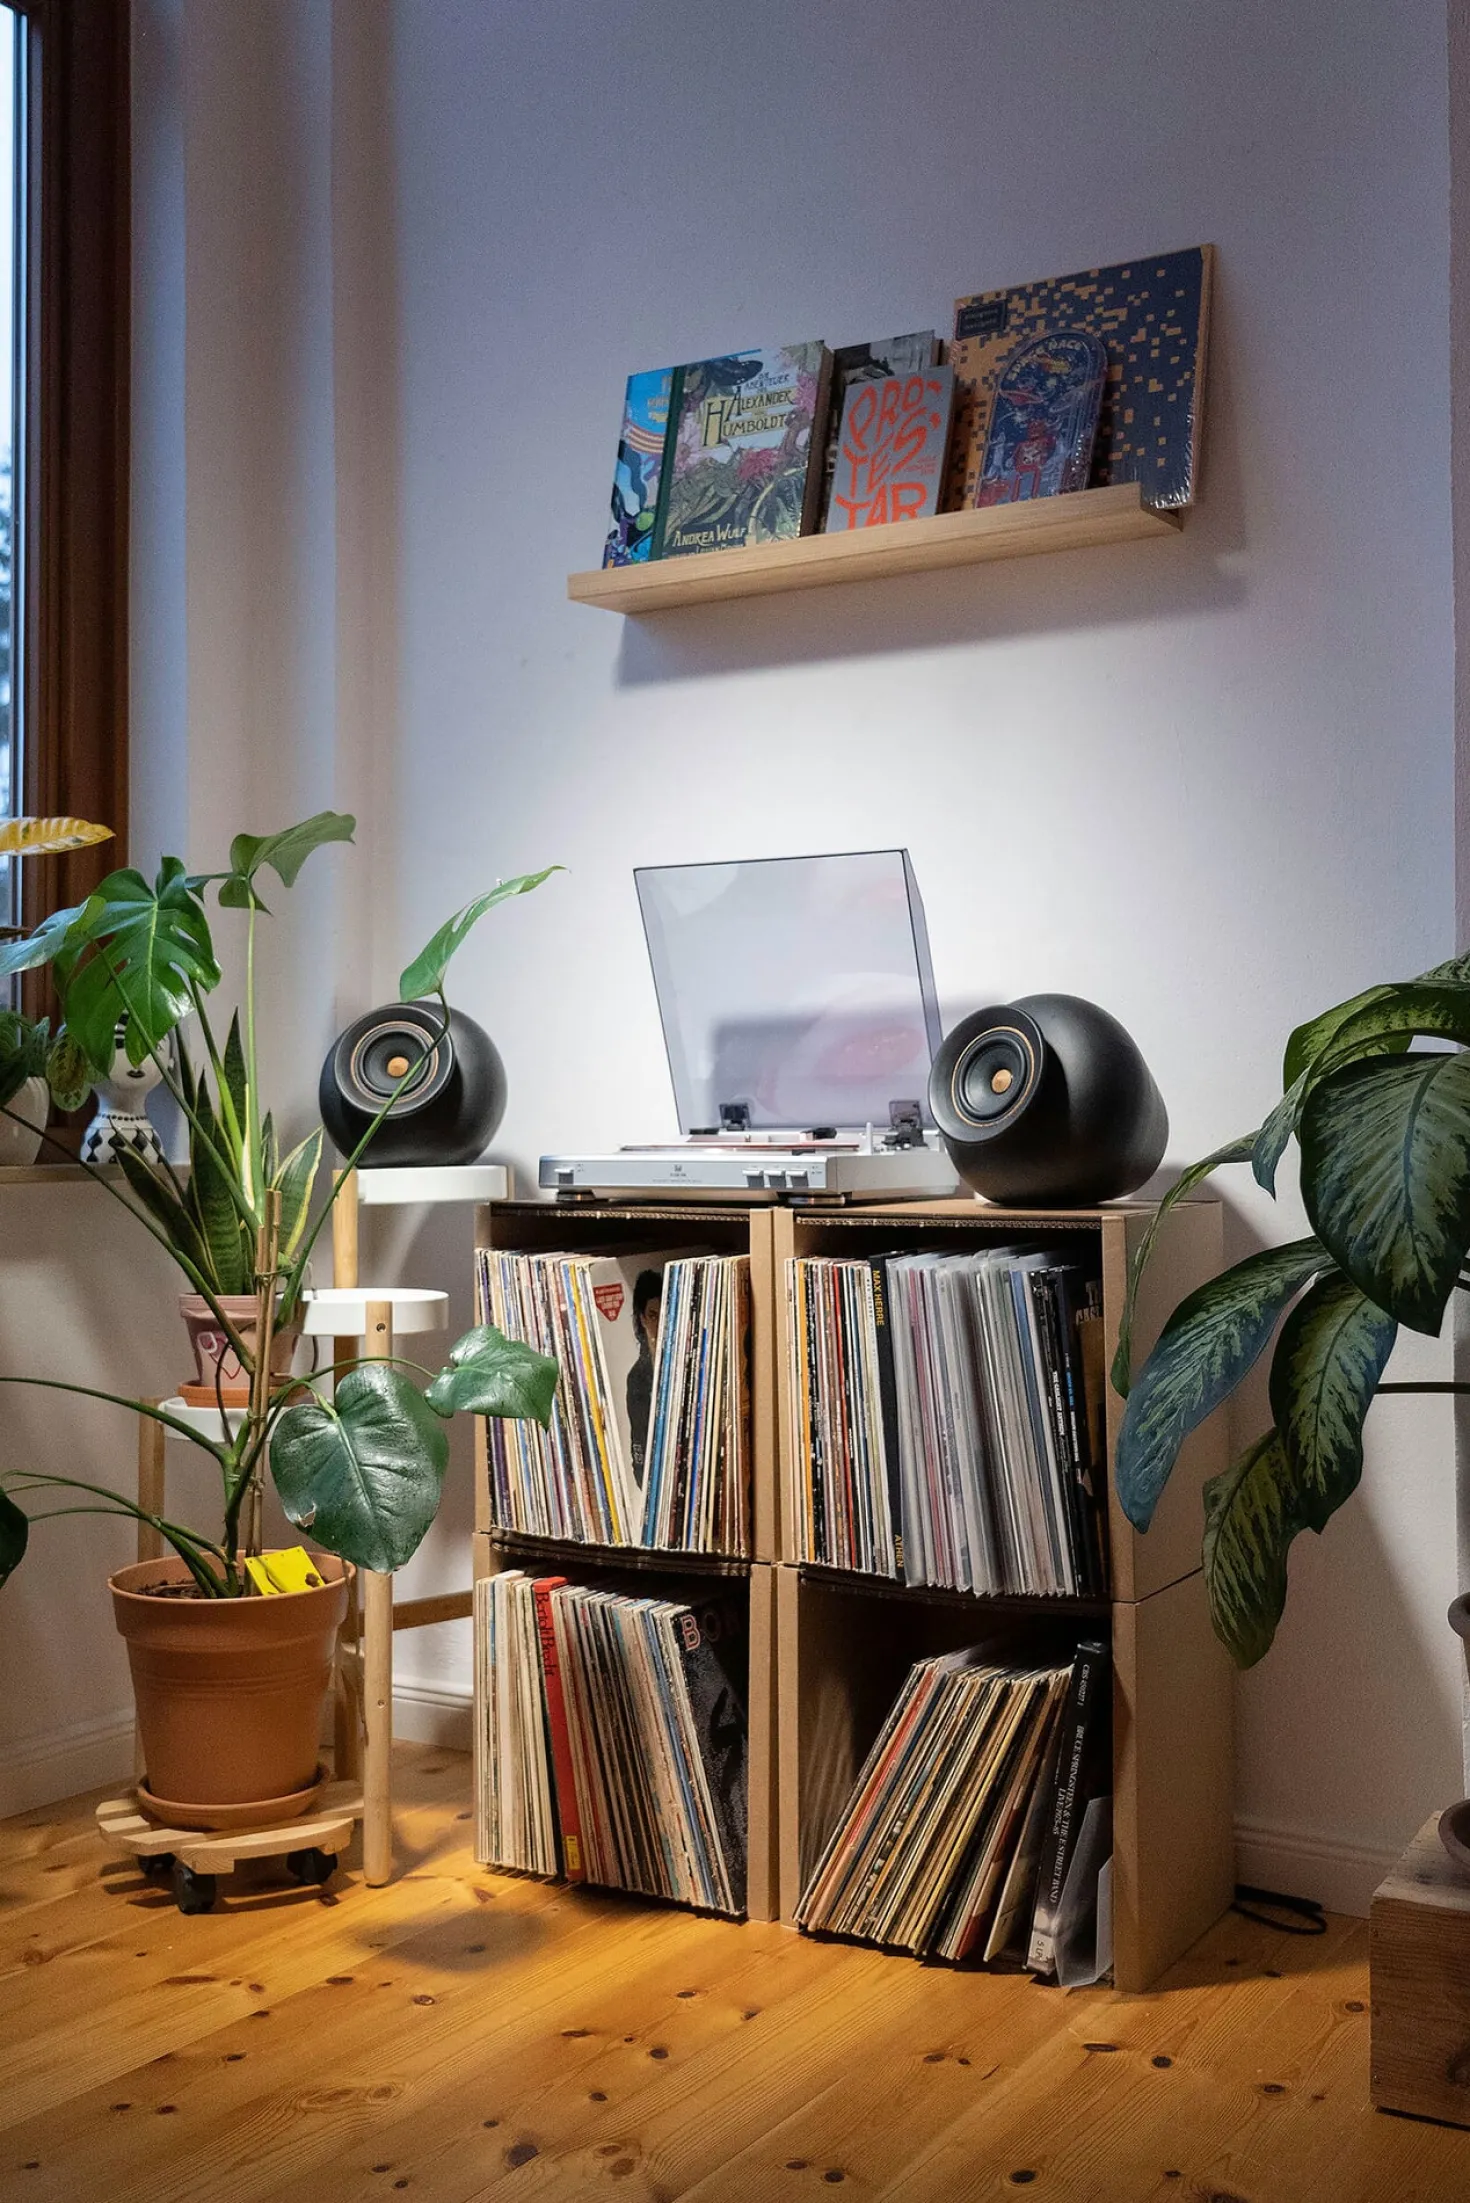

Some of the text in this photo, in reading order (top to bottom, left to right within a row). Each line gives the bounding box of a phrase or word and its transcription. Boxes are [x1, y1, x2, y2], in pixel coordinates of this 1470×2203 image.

[723, 386, 794, 422] ALEXANDER
[703, 400, 787, 447] HUMBOLDT
[672, 523, 747, 547] ANDREA WULF
[872, 1270, 881, 1292] MAX
[874, 1293, 885, 1327] HERRE
[893, 1533, 905, 1568] ATHEN
[1073, 1725, 1085, 1752] BRUCE
[1063, 1753, 1080, 1809] SPRINGSTEEN
